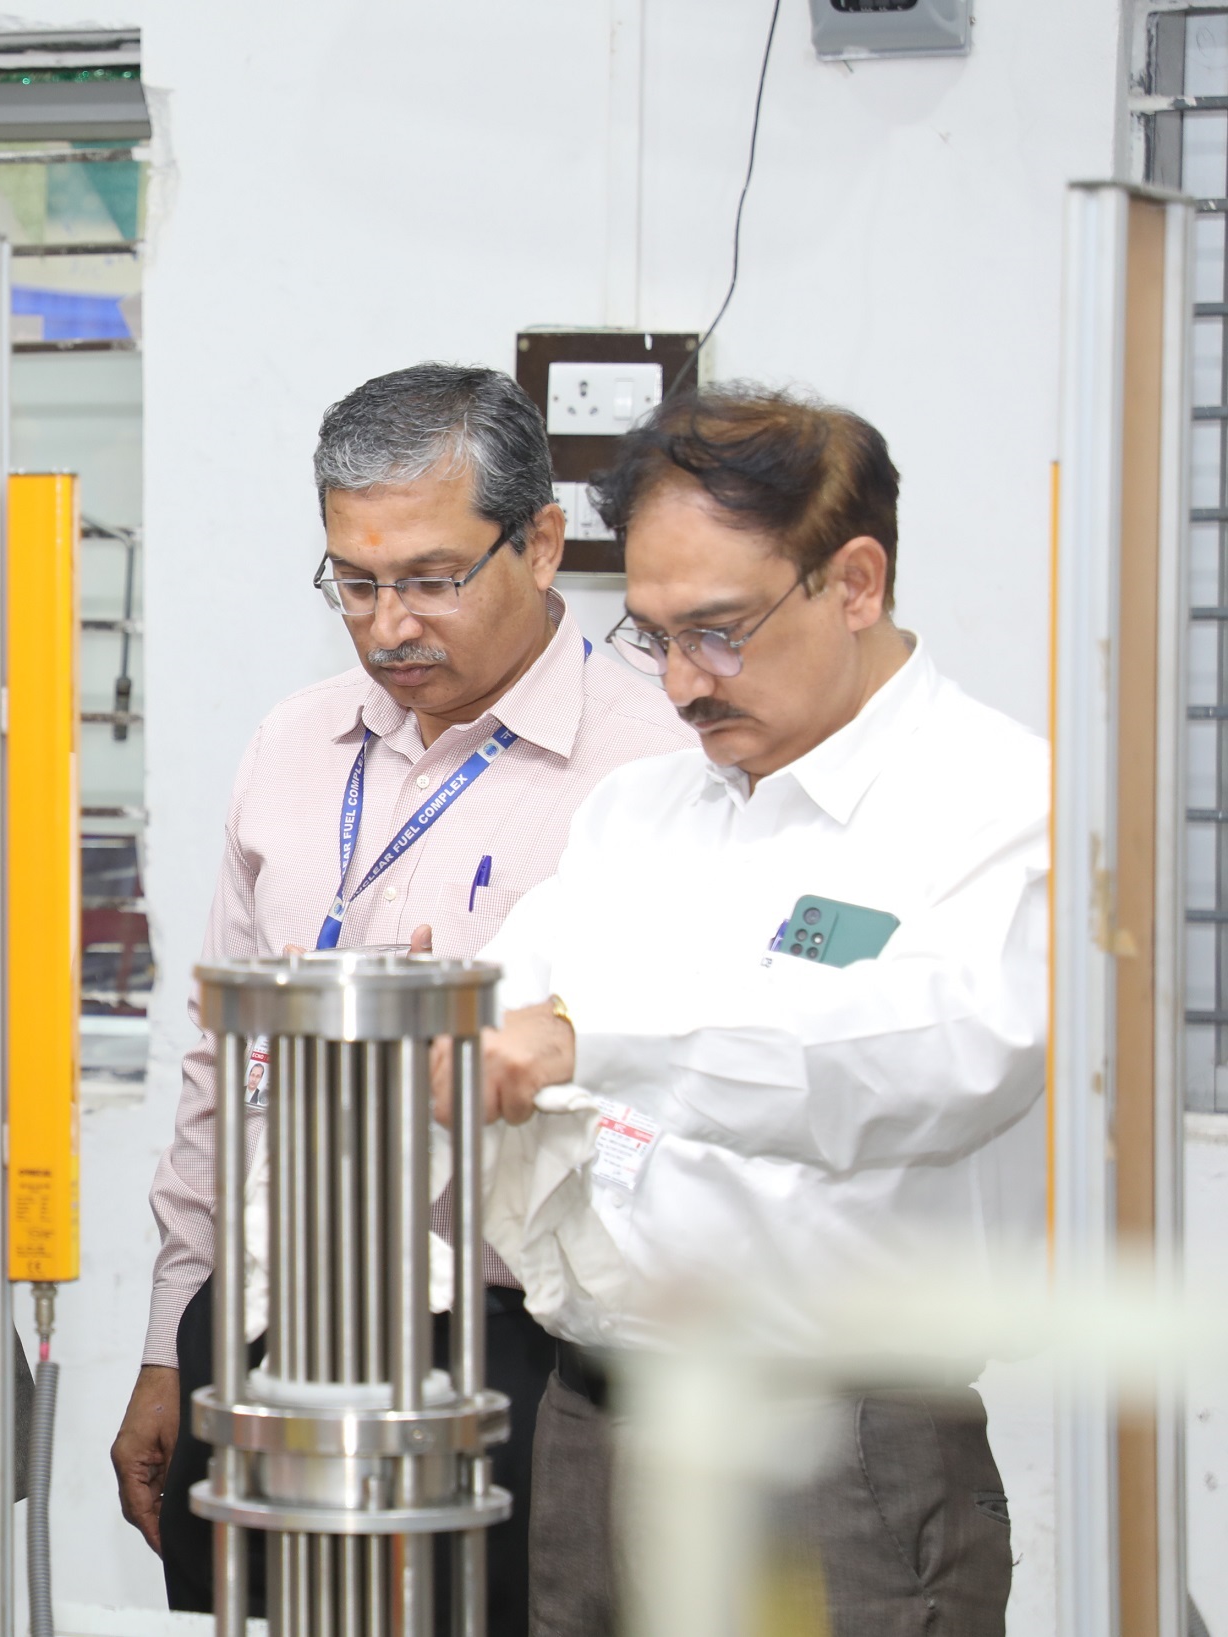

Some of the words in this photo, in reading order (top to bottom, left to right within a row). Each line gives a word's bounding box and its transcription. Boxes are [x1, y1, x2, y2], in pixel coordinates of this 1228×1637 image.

[343, 809, 357, 840] FUEL
[392, 825, 421, 854] FUEL
[417, 773, 469, 825] COMPLEX
